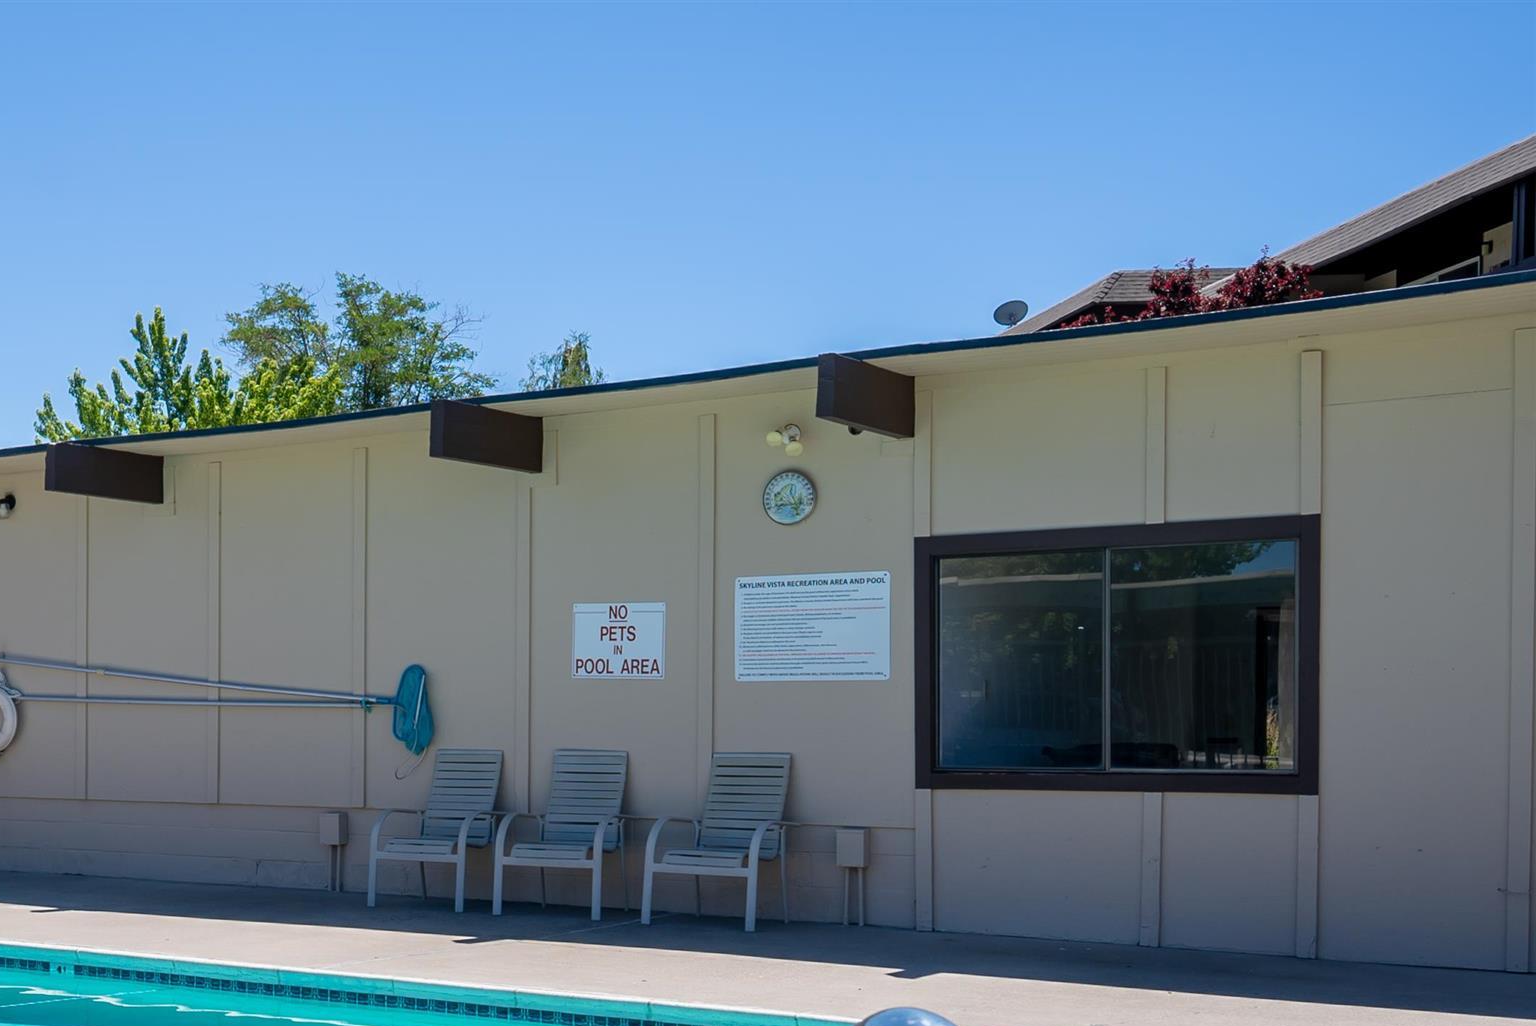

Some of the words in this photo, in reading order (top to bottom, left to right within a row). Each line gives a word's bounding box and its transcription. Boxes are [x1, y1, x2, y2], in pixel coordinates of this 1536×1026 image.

[739, 581, 766, 589] SKYLINE
[767, 580, 786, 588] VISTA
[787, 579, 828, 587] RECREATION
[830, 578, 848, 586] AREA
[849, 577, 865, 585] AND
[609, 605, 628, 619] NO
[600, 626, 636, 641] PETS
[613, 645, 623, 655] IN
[575, 659, 613, 675] POOL
[621, 659, 660, 675] AREA
